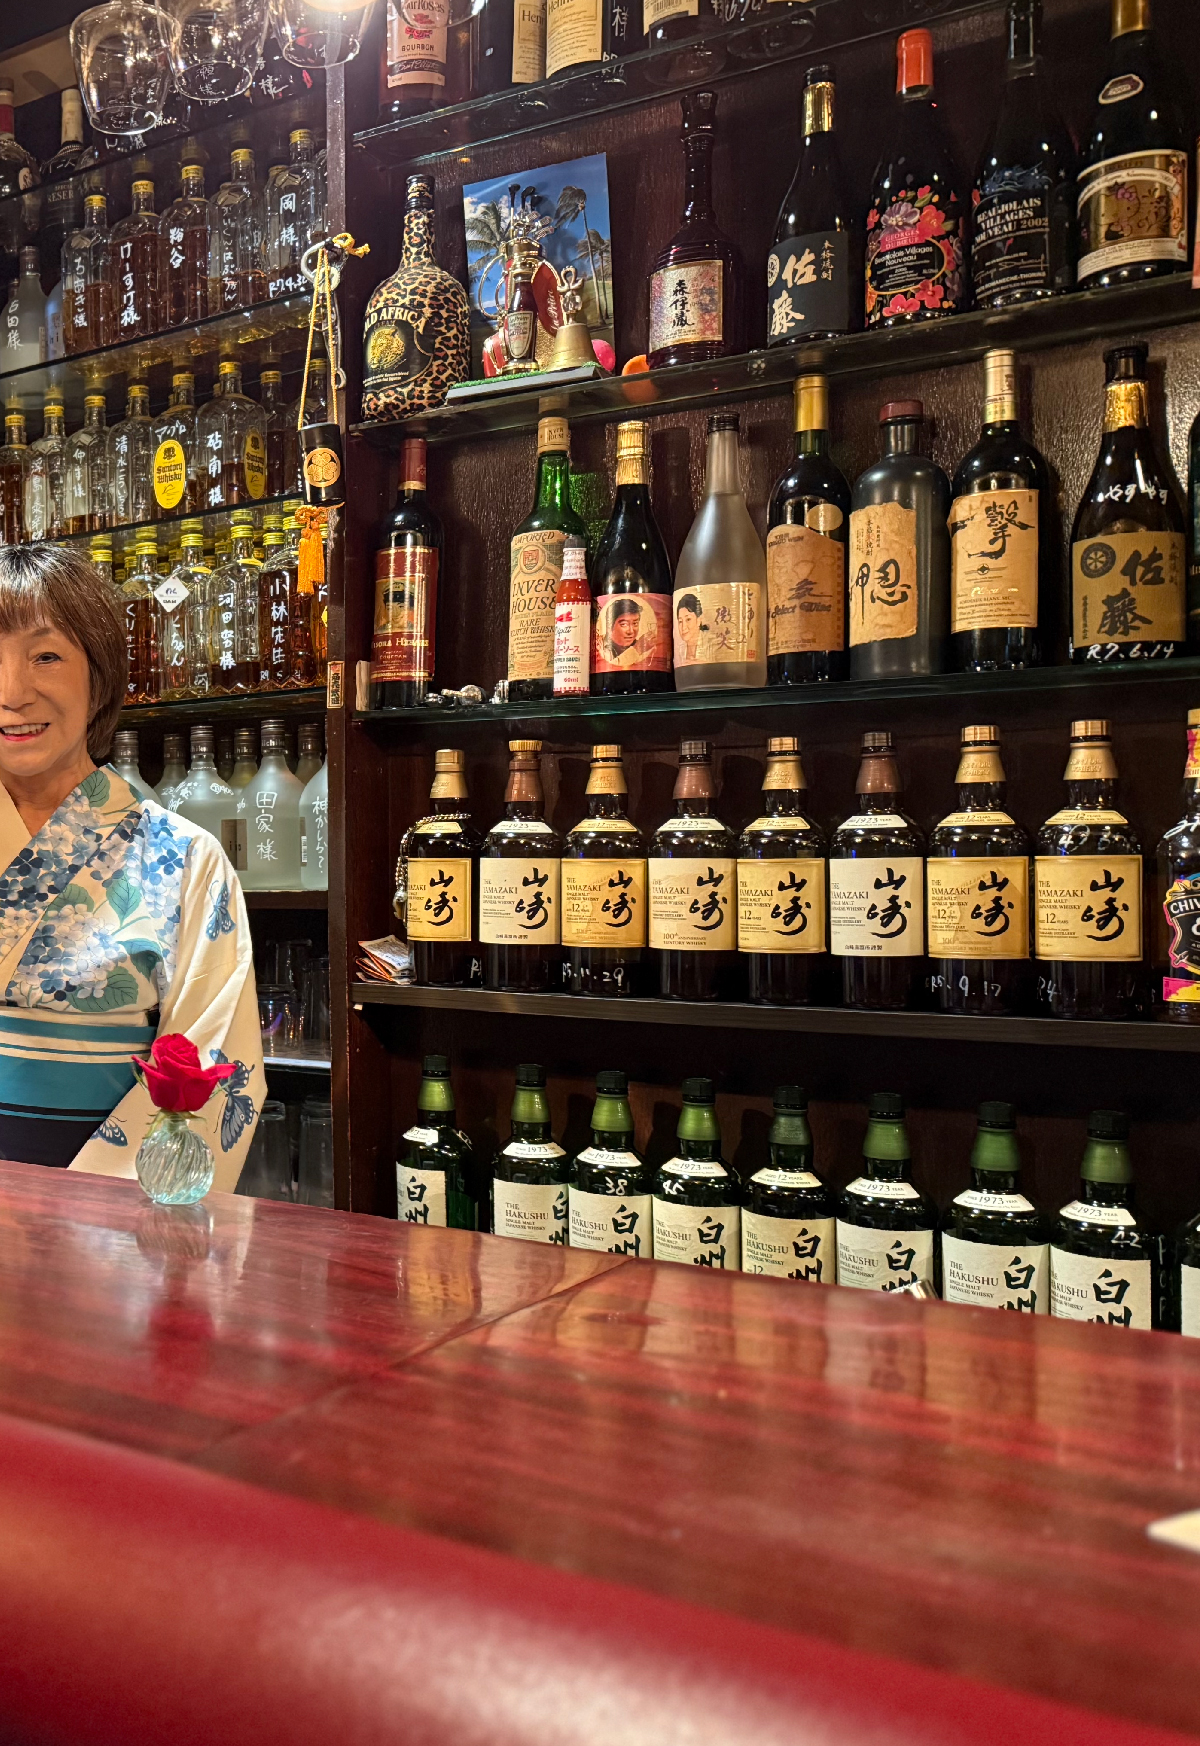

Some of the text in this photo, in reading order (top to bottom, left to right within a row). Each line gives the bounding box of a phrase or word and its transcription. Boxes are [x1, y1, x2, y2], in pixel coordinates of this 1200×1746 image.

[401, 44, 434, 52] BOURBON
[977, 197, 1041, 224] BEAUJOLAIS
[981, 209, 1034, 230] VILLAGES
[1020, 217, 1049, 228] 2002
[885, 230, 919, 242] GEORGES
[885, 255, 917, 267] Nouveau
[770, 248, 818, 336] 佐藤
[380, 306, 427, 335] AFRICA
[156, 463, 184, 475] Suntory
[157, 472, 183, 485] Whisky
[514, 531, 555, 545] IMPORTED
[512, 578, 557, 597] INVER
[1097, 545, 1166, 637] 佐藤
[519, 618, 541, 627] RARE
[424, 869, 458, 927] 山崎
[515, 867, 552, 929] 山崎
[601, 870, 636, 927] 山崎
[689, 867, 728, 931] 山崎
[771, 871, 811, 935] 山崎
[867, 867, 911, 938] 山崎
[970, 871, 1014, 937] 山崎
[571, 904, 580, 912] 12
[1081, 869, 1129, 941] 山崎
[743, 910, 752, 920] 12
[937, 909, 947, 919] 12
[1045, 913, 1056, 924] 12
[595, 1152, 615, 1161] 1973
[680, 1163, 701, 1171] 1973
[605, 1177, 628, 1196] 38
[867, 1183, 891, 1192] 1973
[506, 1202, 520, 1210] THE
[979, 1196, 1005, 1205] 1973
[506, 1210, 549, 1220] HAKUSHU
[572, 1210, 581, 1218] THE
[1077, 1206, 1102, 1217] 1973
[572, 1217, 608, 1232] HAKUSHU
[656, 1227, 692, 1242] HAKUSHU
[746, 1231, 757, 1240] THE
[1111, 1231, 1142, 1248] 42
[746, 1239, 789, 1254] HAKUSHU
[840, 1243, 850, 1252] THE
[840, 1251, 879, 1267] HAKUSHU
[950, 1261, 963, 1270] THE
[949, 1269, 999, 1287] HAKUSHU
[971, 1289, 994, 1298] WHISKY
